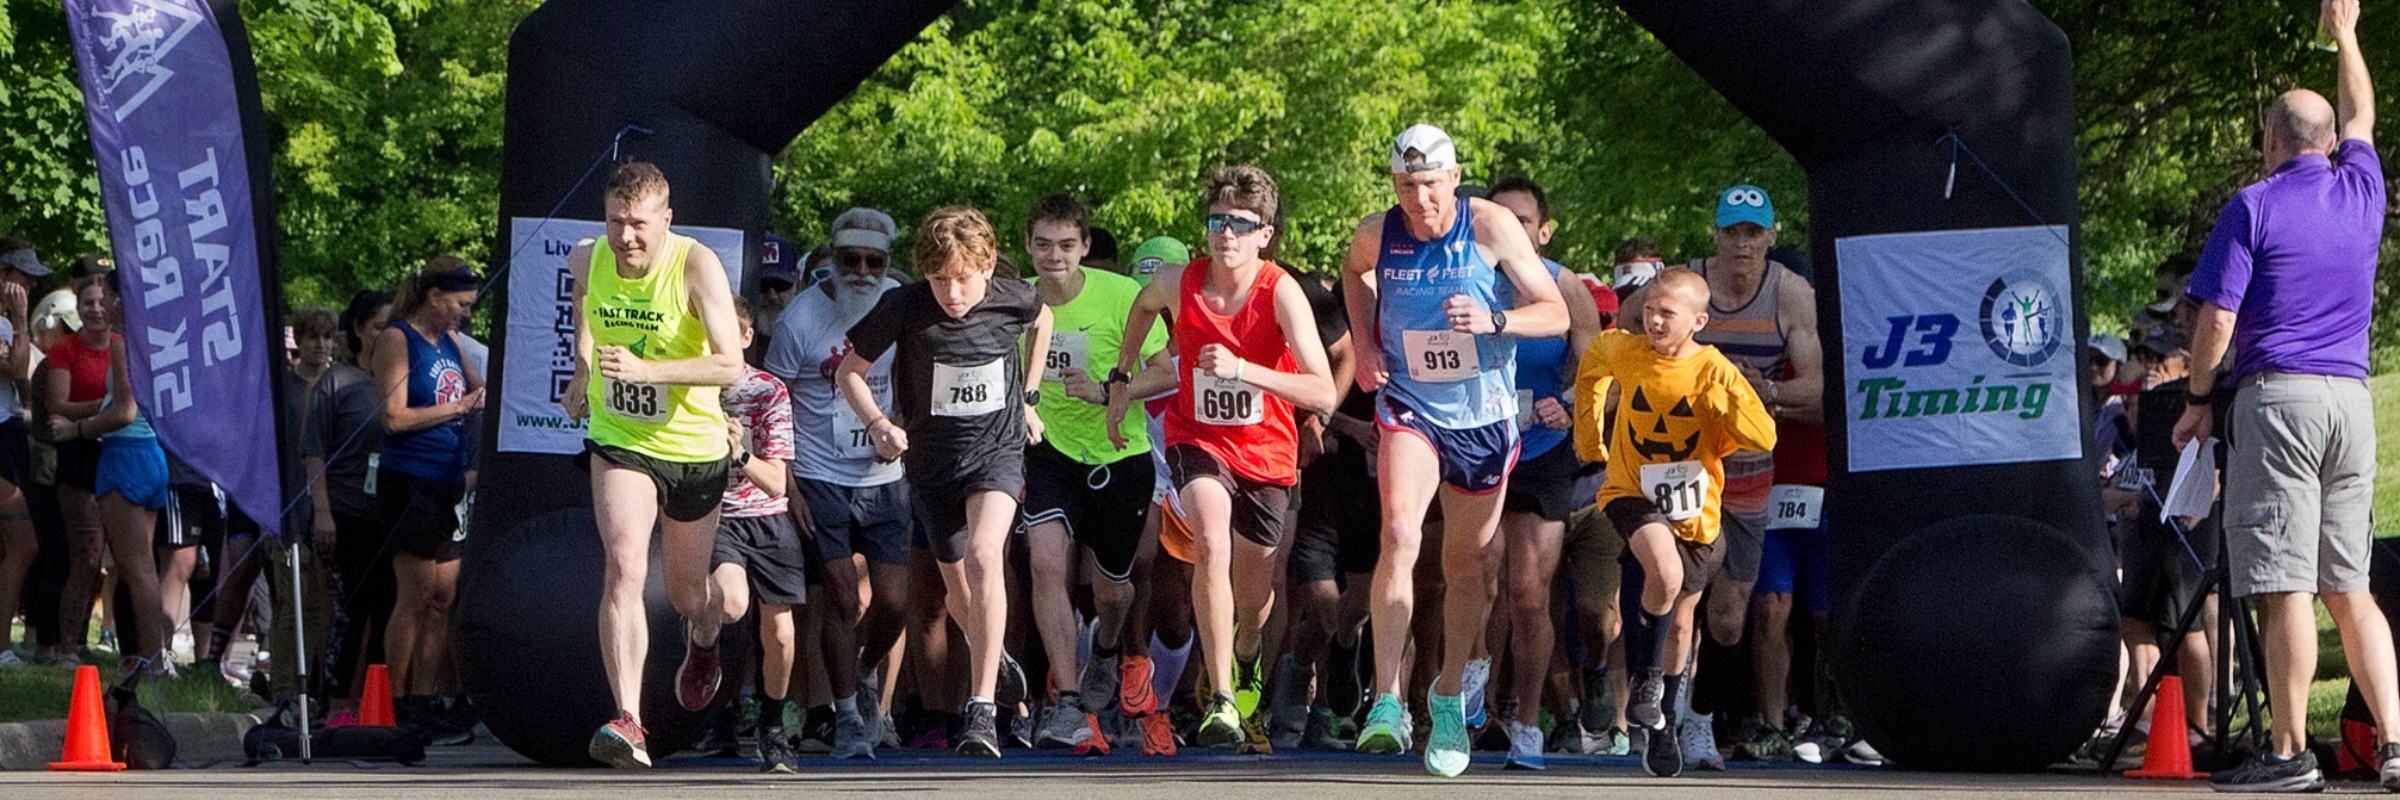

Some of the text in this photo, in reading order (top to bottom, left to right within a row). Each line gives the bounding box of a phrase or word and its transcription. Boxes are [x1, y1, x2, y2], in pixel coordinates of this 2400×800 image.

[545, 240, 572, 256] Liv
[1384, 265, 1475, 280] FLEET FEET
[1396, 285, 1464, 296] RACING TEAM
[598, 307, 664, 322] FAST TRACK
[1861, 313, 1960, 370] J3
[1046, 350, 1071, 369] 59
[1424, 350, 1460, 370] 913
[612, 381, 657, 417] 833
[950, 384, 987, 403] 788
[1857, 375, 2051, 420] Timing
[1204, 389, 1252, 420] 690
[1655, 480, 1701, 514] 811
[1778, 501, 1806, 518] 784
